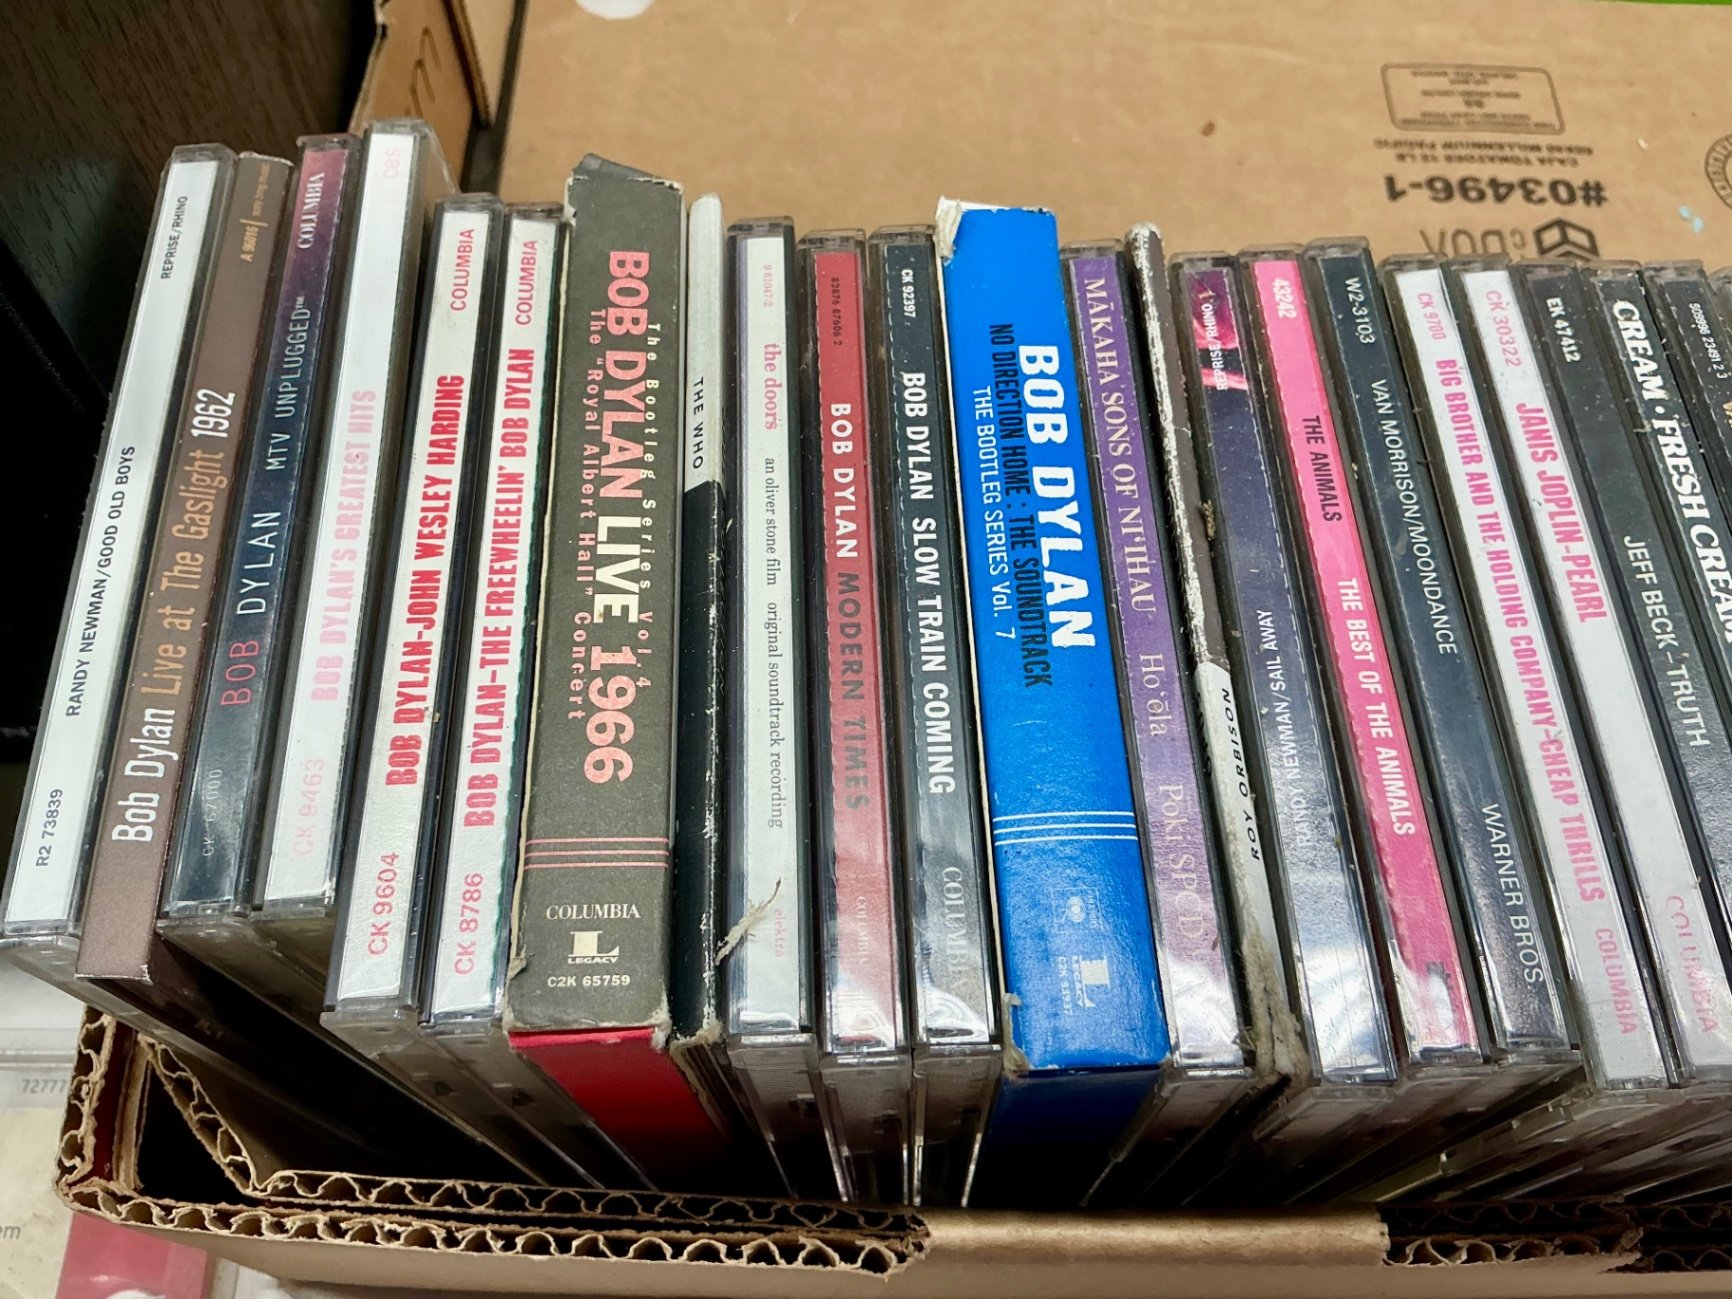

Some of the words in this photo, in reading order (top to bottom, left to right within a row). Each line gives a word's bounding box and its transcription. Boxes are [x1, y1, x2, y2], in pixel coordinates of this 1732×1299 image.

[382, 147, 402, 180] CBS
[1384, 174, 1608, 207] #03496-1
[160, 195, 189, 280] REPRISE/RHINO
[297, 171, 325, 249] COLUMBIA
[449, 228, 476, 312] COLUMBIA
[514, 239, 538, 326] COLUMBIA
[605, 250, 651, 336] BOB
[901, 269, 914, 284] CK
[1271, 277, 1297, 319] 43242
[588, 308, 607, 346] The
[902, 285, 917, 319] 92397
[1344, 277, 1376, 345] W2-3103
[1417, 292, 1432, 309] CK
[1423, 313, 1447, 341] 9700
[1485, 290, 1507, 310] CK
[1546, 297, 1564, 316] EK
[645, 323, 662, 362] The
[762, 343, 783, 372] the
[988, 323, 1014, 348] NO
[1199, 302, 1228, 391] REPRISE/RHINO
[1492, 313, 1522, 368] 30322
[1553, 318, 1582, 363] 47412
[505, 348, 536, 411] DYLAN
[692, 377, 705, 416] THE
[903, 371, 929, 418] BOB
[991, 350, 1024, 438] DIRECTION
[1018, 345, 1069, 445] BOB
[1370, 379, 1393, 416] VAN
[1436, 358, 1462, 388] BIG
[1716, 371, 1729, 379] 3
[191, 387, 236, 438] 1962
[352, 389, 377, 434] HITS
[427, 374, 466, 466] HARDING
[599, 349, 648, 499] DYLAN
[639, 378, 660, 481] Bootleg
[762, 376, 784, 431] doors
[829, 403, 855, 455] BOB
[972, 386, 994, 421] THE
[1101, 391, 1133, 459] SONS
[1302, 415, 1326, 445] THE
[1444, 391, 1484, 467] BROTHER
[1612, 300, 1670, 400] CREAM
[1651, 418, 1711, 520] FRESH
[265, 432, 291, 471] MTV
[500, 417, 530, 459] BOB
[692, 422, 705, 470] WHO
[1515, 402, 1558, 464] JANIS
[115, 446, 136, 488] BOYS
[334, 438, 369, 541] GREATEST
[580, 443, 602, 520] Albert
[765, 457, 775, 469] an
[905, 424, 935, 500] DYLAN
[976, 425, 1001, 506] BOOTLEG
[1112, 461, 1139, 500] OF
[1308, 449, 1343, 523] ANIMALS
[1465, 470, 1495, 507] AND
[107, 490, 127, 530] OLD
[171, 449, 227, 541] Gaslight
[414, 475, 454, 561] WESLEY
[765, 473, 778, 516] oliver
[831, 467, 859, 560] DYLAN
[484, 465, 526, 619] FREEWHEELIN'
[638, 498, 657, 590] Series
[765, 518, 777, 556] stone
[911, 517, 942, 587] SLOW
[984, 509, 1009, 577] SERIES
[1008, 513, 1035, 551] THE
[1380, 418, 1458, 655] MORRISON/MOONDANCE
[1476, 511, 1506, 544] THE
[1536, 469, 1608, 623] JOPLIN-PEARL
[160, 551, 205, 592] The
[236, 510, 282, 616] DYLAN
[592, 515, 643, 624] LIVE
[765, 559, 782, 586] film
[1032, 465, 1097, 648] DYLAN
[1623, 535, 1659, 587] JEFF
[81, 524, 119, 653] NEWMAN/GOOD
[319, 547, 359, 645] DYLAN'S
[1337, 577, 1365, 612] THE
[1486, 547, 1529, 630] HOLDING
[158, 604, 195, 632] at
[763, 602, 783, 659] original
[837, 571, 867, 701] MODERN
[917, 594, 947, 673] TRAIN
[995, 626, 1016, 640] 7
[1012, 555, 1054, 689] SOUNDTRACK
[1256, 608, 1277, 654] AWAY
[1345, 618, 1377, 664] BEST
[140, 645, 188, 696] Live
[220, 639, 260, 707] BOB
[393, 569, 443, 725] DYLAN-JOHN
[568, 611, 593, 720] Concert
[66, 659, 91, 717] RANDY
[311, 655, 344, 701] BOB
[470, 625, 513, 765] DYLAN-THE
[637, 675, 652, 688] 4
[767, 661, 786, 748] soundtrack
[1358, 669, 1384, 696] OF
[125, 707, 179, 779] Dylan
[583, 645, 639, 784] 1966
[923, 681, 956, 795] COMING
[1221, 687, 1249, 798] ORBISON
[1261, 655, 1302, 779] NEWMAN/SAIL
[1365, 703, 1394, 739] THE
[1510, 633, 1580, 808] COMPANY-CHEAP
[298, 758, 325, 815] 9463
[386, 734, 423, 786] BOB
[843, 715, 870, 811] TIMES
[41, 788, 63, 840] 73839
[112, 793, 159, 843] Bob
[464, 772, 497, 827] BOB
[767, 750, 785, 830] recording
[1159, 783, 1188, 843] Poki
[1289, 785, 1313, 847] RANDY
[1375, 744, 1416, 837] ANIMALS
[36, 843, 51, 867] R2
[292, 822, 315, 856] CK
[1243, 810, 1260, 861] ROY
[1481, 803, 1525, 907] WARNER
[1559, 813, 1606, 903] THRILLS
[373, 852, 400, 917] 9604
[459, 872, 485, 933] 8786
[546, 902, 641, 921] COLUMBIA
[367, 922, 391, 956] CK
[772, 907, 786, 959] elektra
[942, 865, 970, 990] COLUMBIA
[454, 942, 476, 975] CK
[547, 976, 578, 989] C2K
[582, 974, 631, 987] 65759
[567, 956, 619, 965] LEGACY
[1595, 927, 1639, 1035] COLUMBIA
